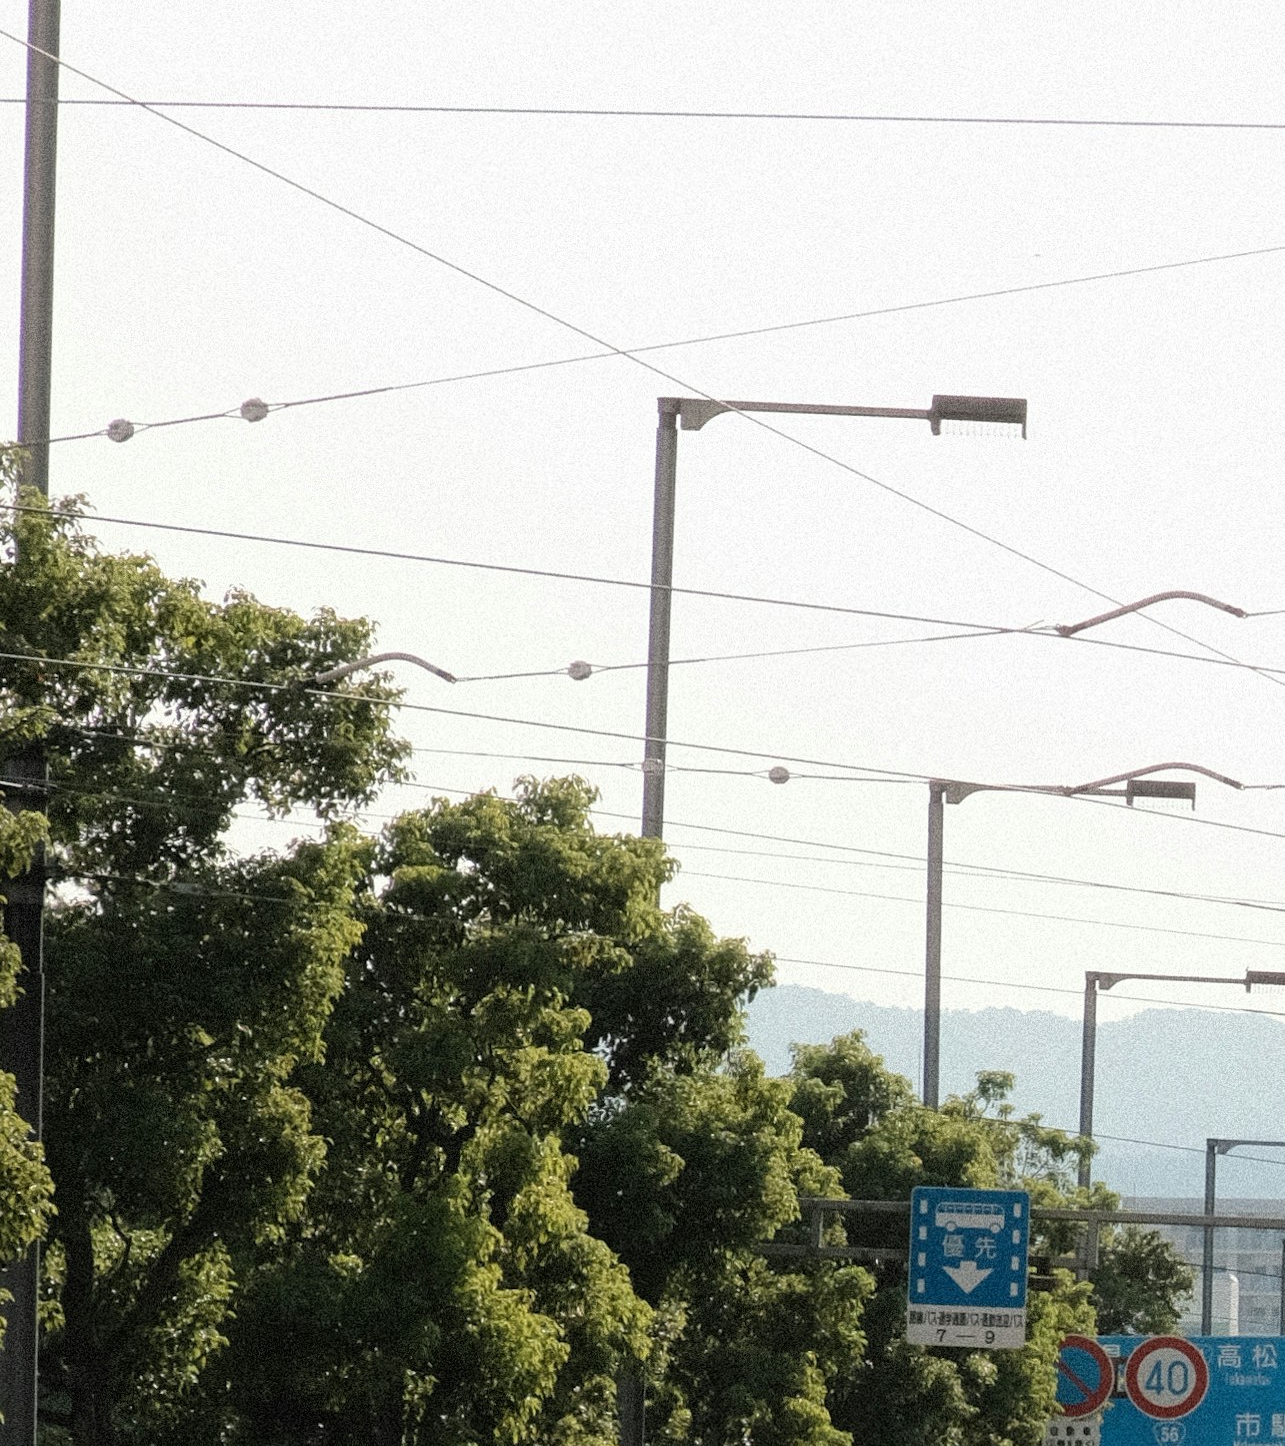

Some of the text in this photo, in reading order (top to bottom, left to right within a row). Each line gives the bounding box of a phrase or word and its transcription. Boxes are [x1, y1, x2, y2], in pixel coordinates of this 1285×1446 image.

[941, 1234, 998, 1260] 優先
[936, 1329, 947, 1343] 7
[985, 1330, 996, 1345] 9
[1217, 1343, 1279, 1370] 高松
[1145, 1359, 1190, 1396] 40
[1160, 1428, 1179, 1443] 56
